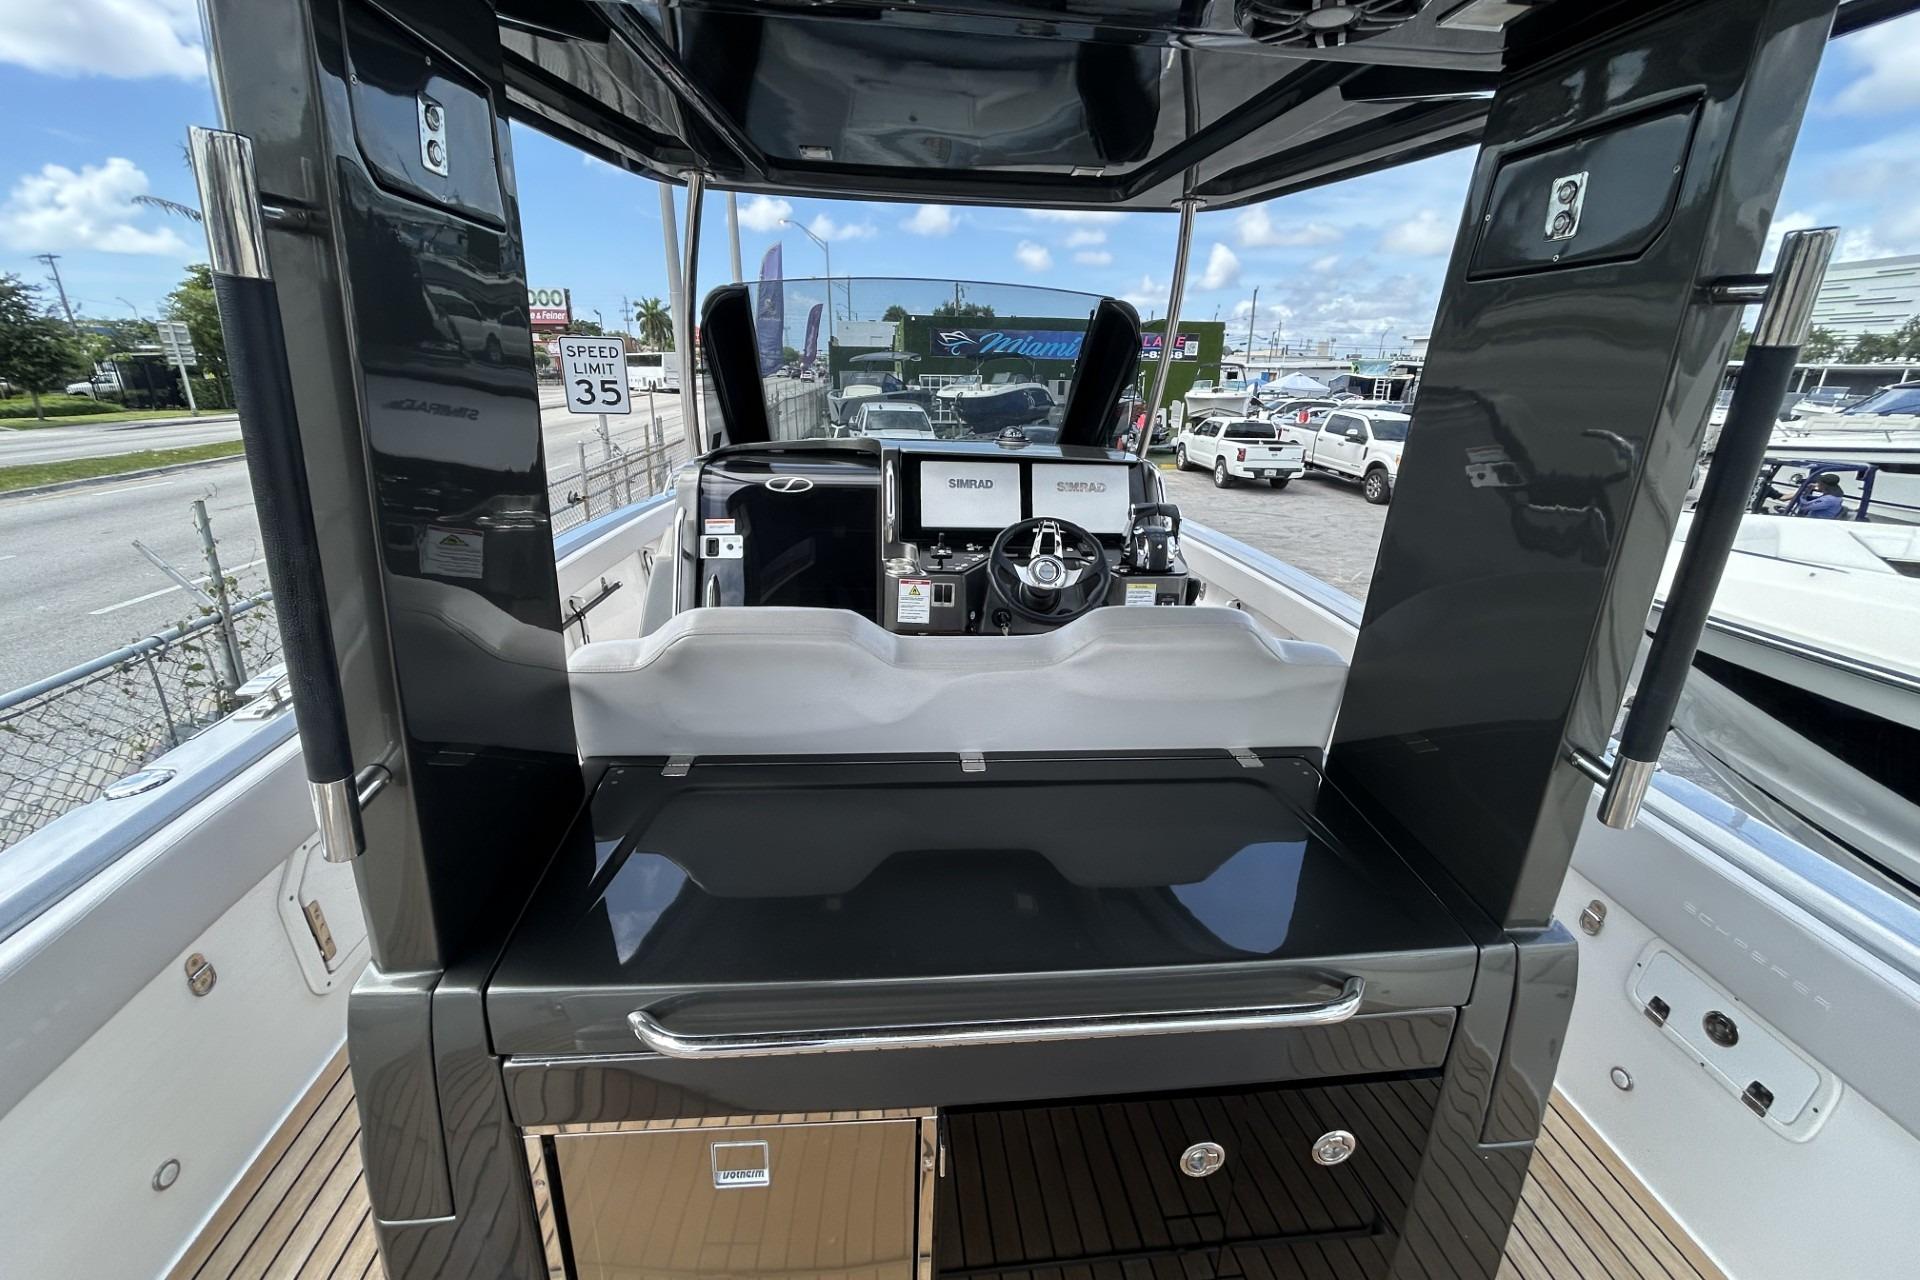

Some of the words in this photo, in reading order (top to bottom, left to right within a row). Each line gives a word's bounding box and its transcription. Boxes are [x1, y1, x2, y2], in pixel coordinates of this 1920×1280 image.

[979, 332, 1082, 357] Miami
[566, 345, 619, 359] SPEED
[573, 362, 614, 375] LIMIT
[575, 379, 622, 406] 35
[948, 478, 993, 489] SIMRAD
[1056, 481, 1106, 493] SIMRAD
